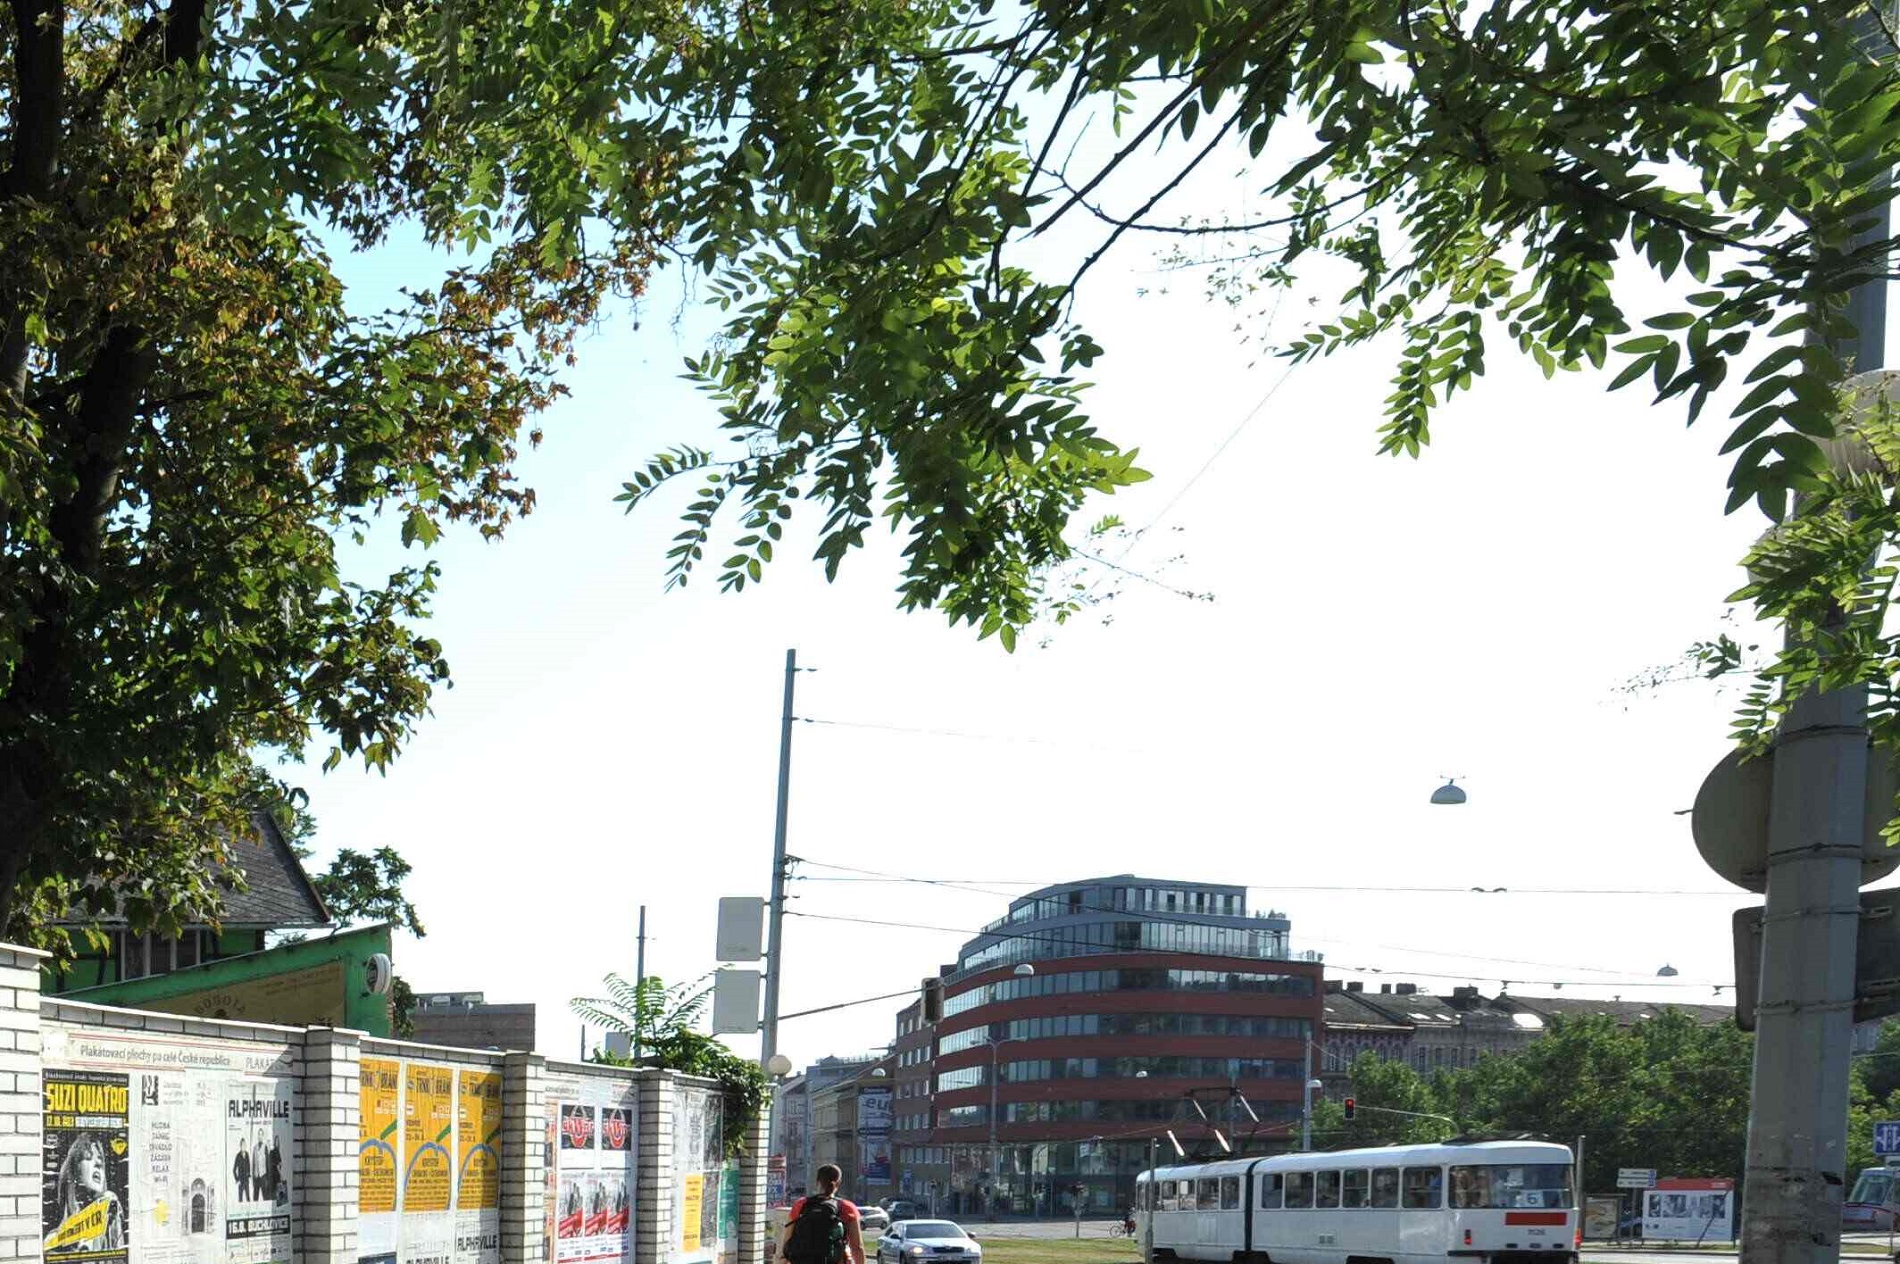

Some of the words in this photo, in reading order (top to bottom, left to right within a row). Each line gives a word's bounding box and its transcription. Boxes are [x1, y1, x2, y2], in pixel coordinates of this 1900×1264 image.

[46, 1083, 76, 1112] SUZI
[78, 1085, 127, 1114] QUATRO
[228, 1099, 289, 1117] ALPHAVILLE
[457, 1234, 498, 1250] ALPHAVILLE
